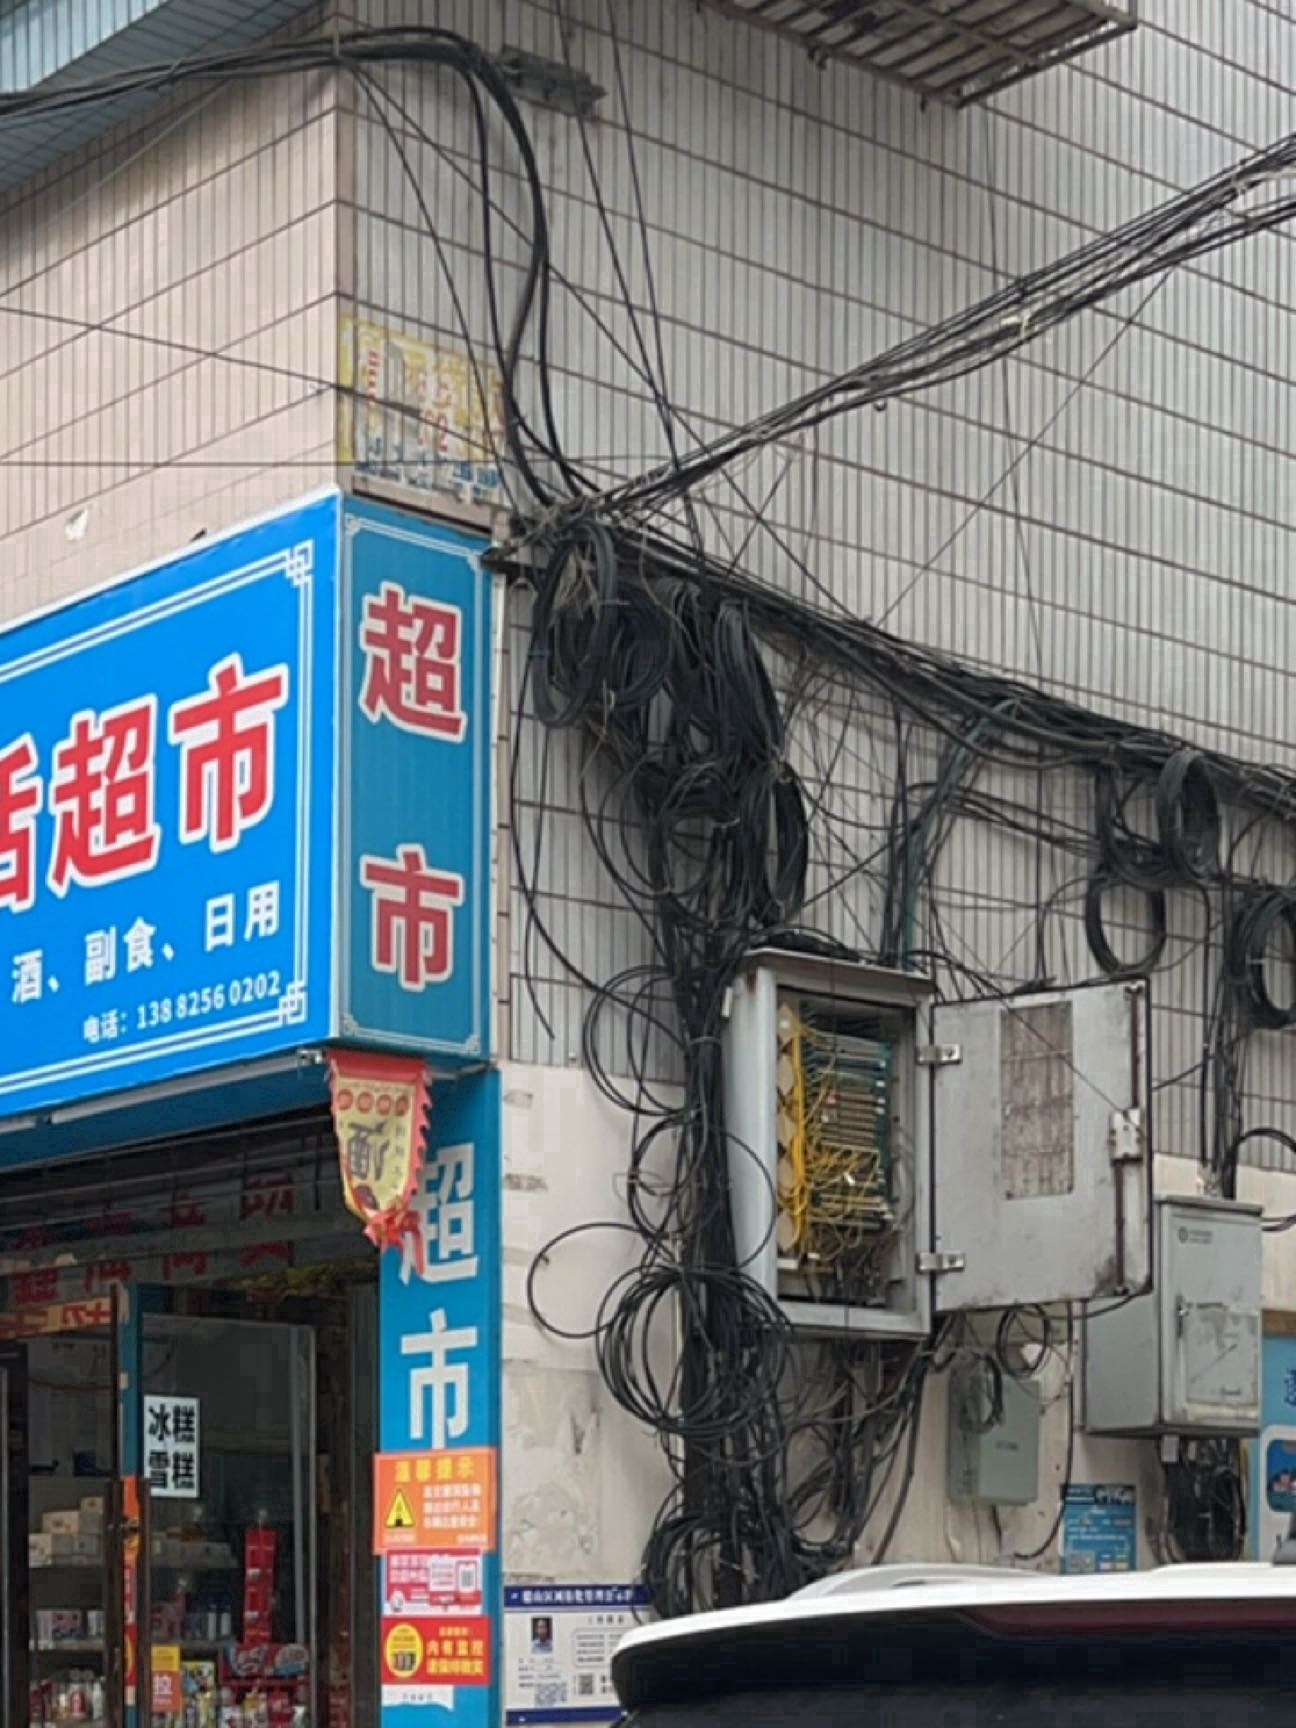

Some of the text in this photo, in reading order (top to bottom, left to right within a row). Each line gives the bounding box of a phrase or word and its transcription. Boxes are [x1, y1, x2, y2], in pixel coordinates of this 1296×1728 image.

[359, 581, 466, 991] 超市
[148, 1403, 197, 1443] 冰糕
[148, 1449, 197, 1490] 雪糕
